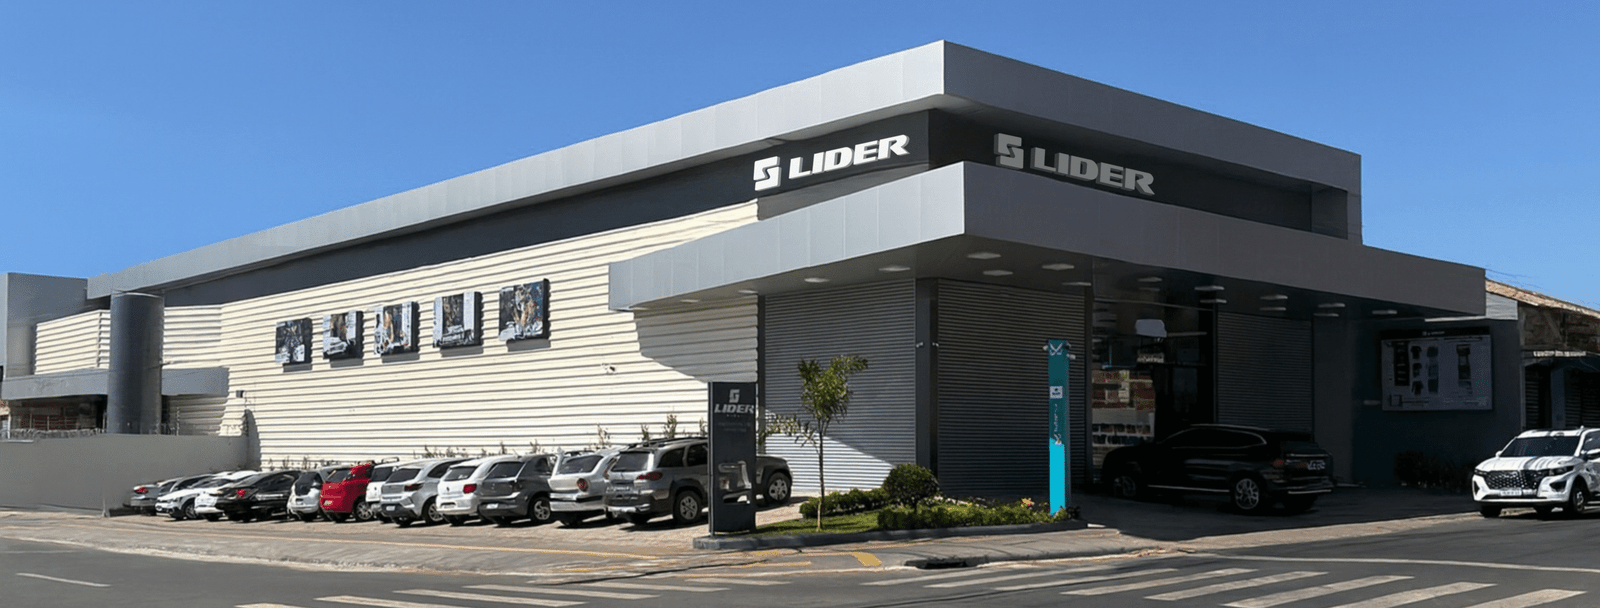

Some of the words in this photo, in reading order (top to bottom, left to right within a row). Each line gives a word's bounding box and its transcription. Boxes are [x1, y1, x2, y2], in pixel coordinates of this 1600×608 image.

[788, 134, 910, 180] LIDER
[1030, 147, 1155, 196] LIDER
[714, 403, 755, 414] LIDER
